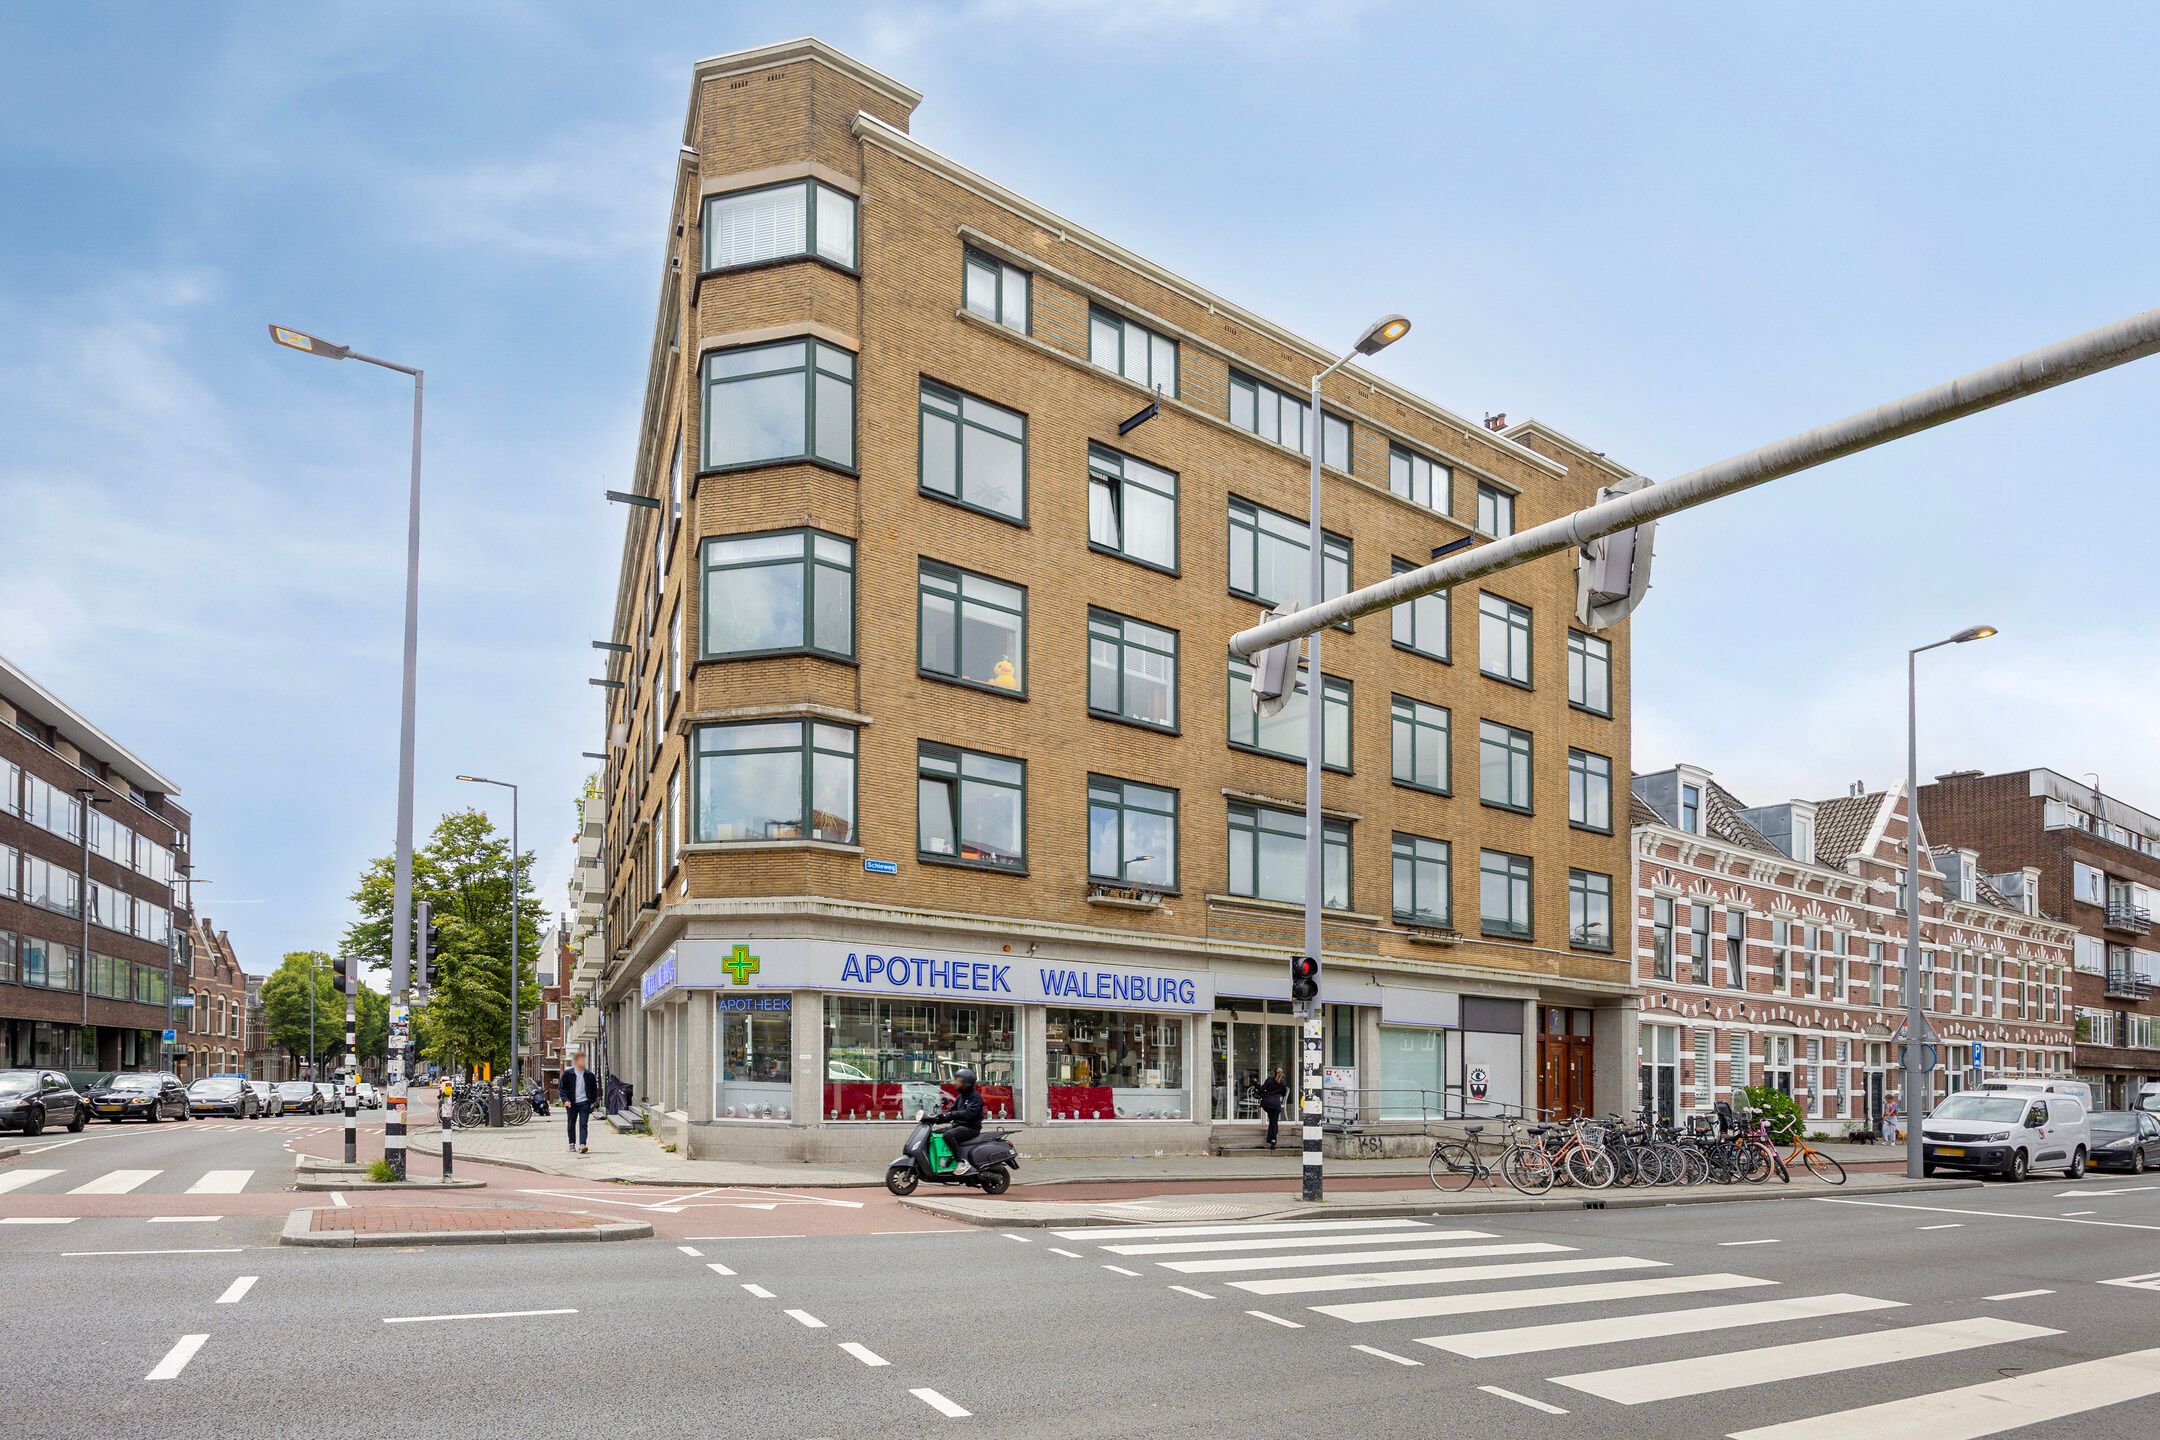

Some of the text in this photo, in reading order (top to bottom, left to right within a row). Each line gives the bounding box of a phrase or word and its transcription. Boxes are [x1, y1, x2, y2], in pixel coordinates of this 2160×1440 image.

[867, 861, 895, 872] Schieweg
[841, 953, 1195, 1004] APOTHEEK WALENBURG
[719, 998, 791, 1011] APOTHEEK
